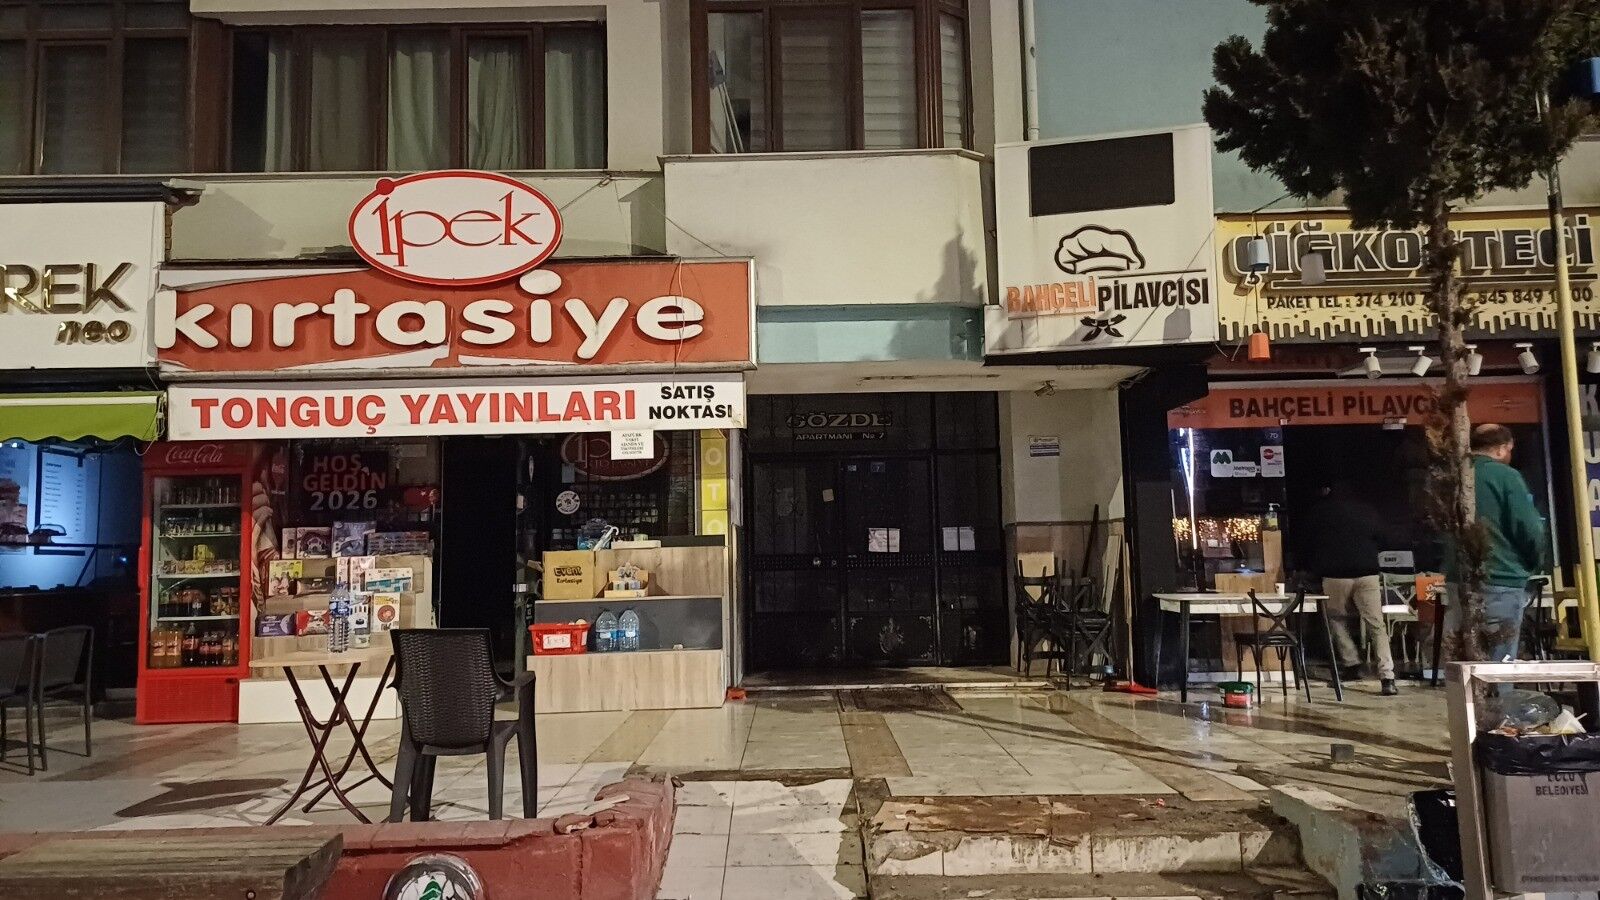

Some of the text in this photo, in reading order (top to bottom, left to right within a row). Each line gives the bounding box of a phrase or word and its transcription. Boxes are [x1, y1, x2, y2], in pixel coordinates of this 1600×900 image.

[0, 262, 133, 314] REK
[1006, 276, 1210, 314] BAHÇELİ PİLAVCISI
[1267, 296, 1311, 309] PAKET
[1318, 295, 1341, 308] TEL
[1356, 293, 1383, 307] 374
[1389, 291, 1416, 306] 210
[1512, 288, 1543, 304] 849
[154, 268, 705, 359] kırtasiye
[55, 320, 131, 345] neo
[660, 384, 716, 403] SATIŞ
[1229, 391, 1334, 420] BAHÇELİ
[191, 389, 636, 434] TONGUÇ YAYINLARI
[648, 404, 733, 421] NOKTASI
[310, 489, 378, 511] 2026
